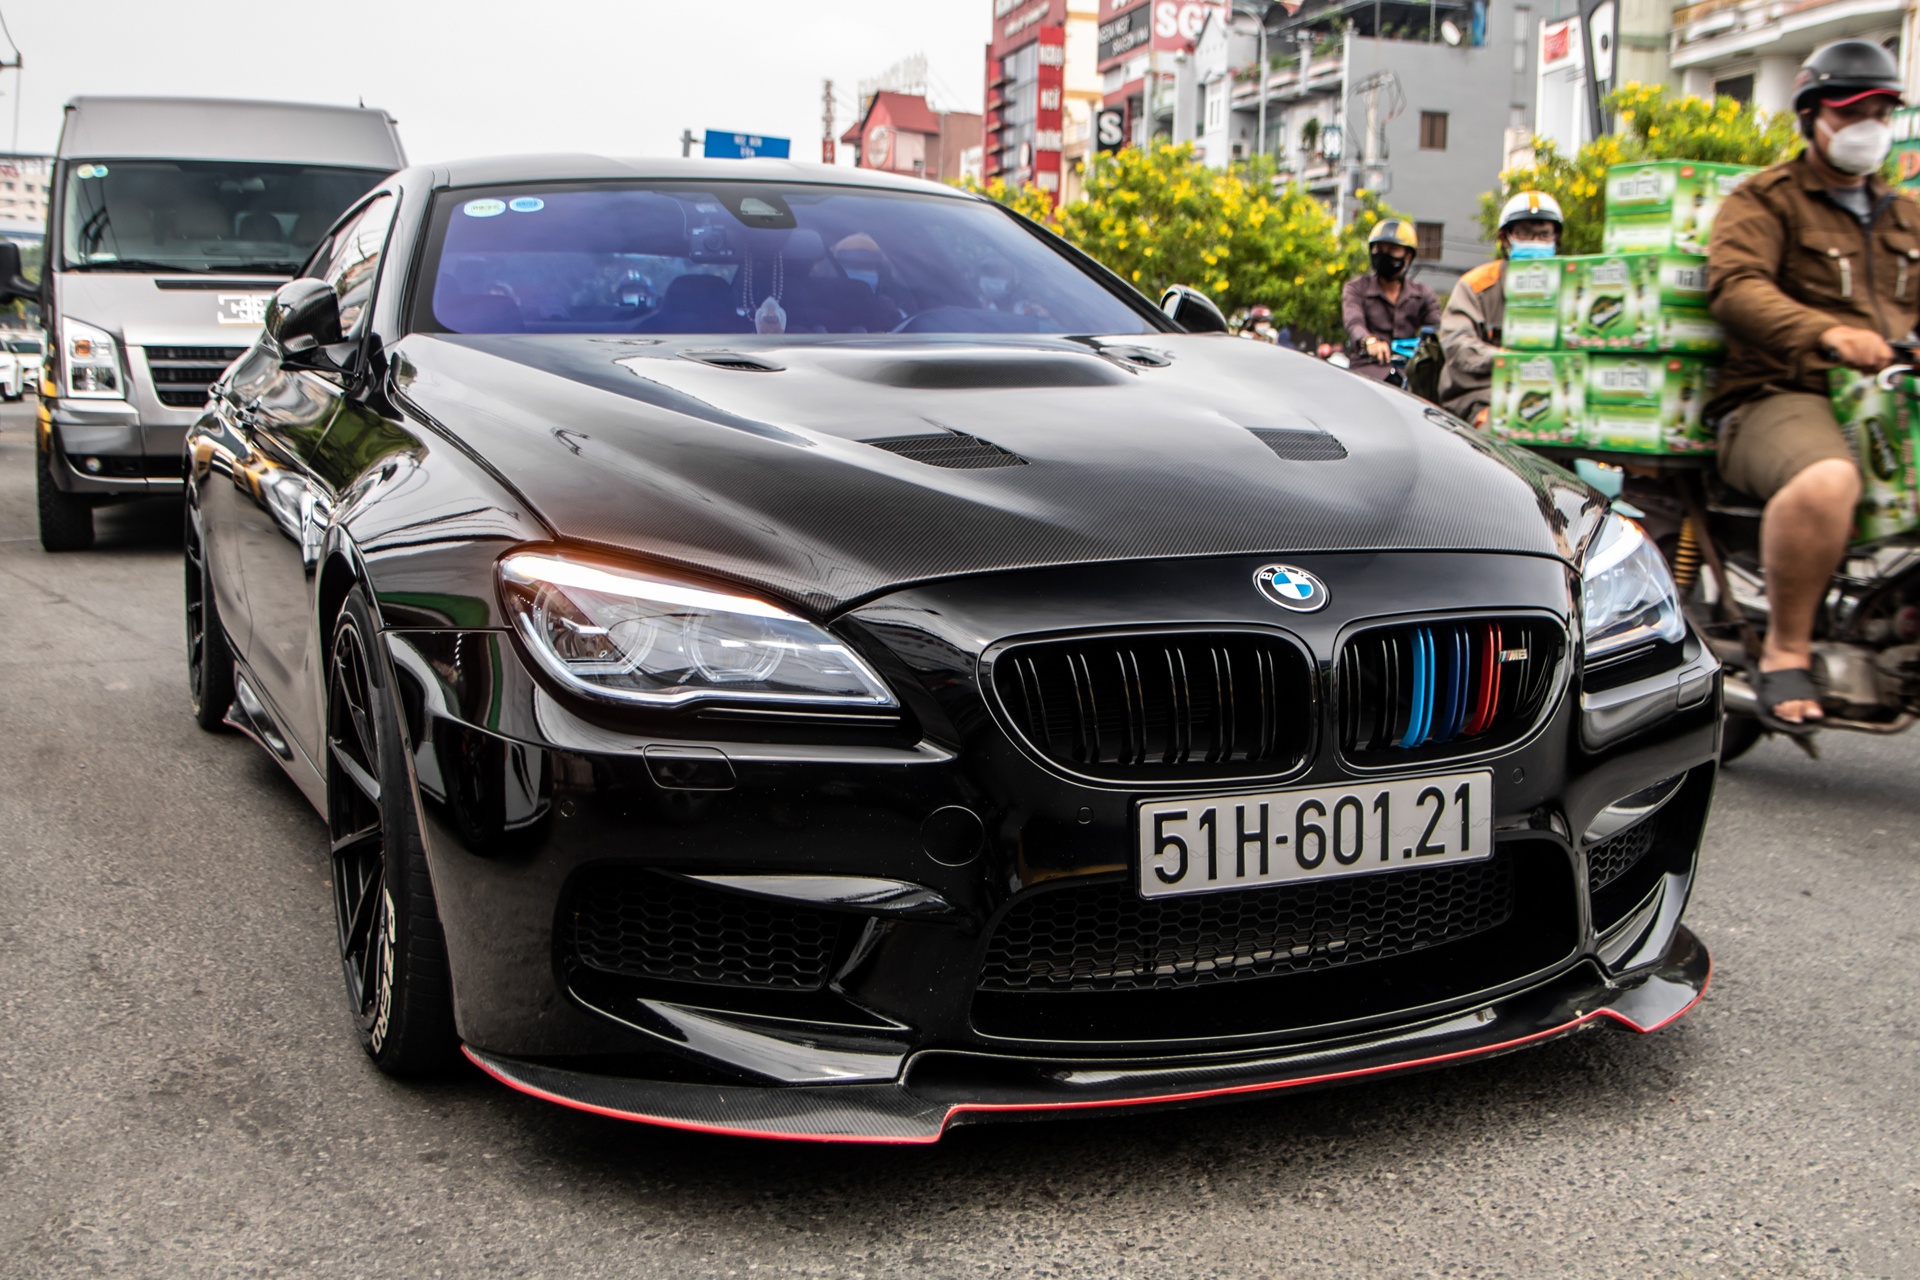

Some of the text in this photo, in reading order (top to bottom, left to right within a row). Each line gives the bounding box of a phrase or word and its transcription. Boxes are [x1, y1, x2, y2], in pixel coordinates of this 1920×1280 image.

[1099, 111, 1122, 145] S
[1261, 566, 1310, 581] BMW
[1153, 782, 1470, 884] 51H-601.21
